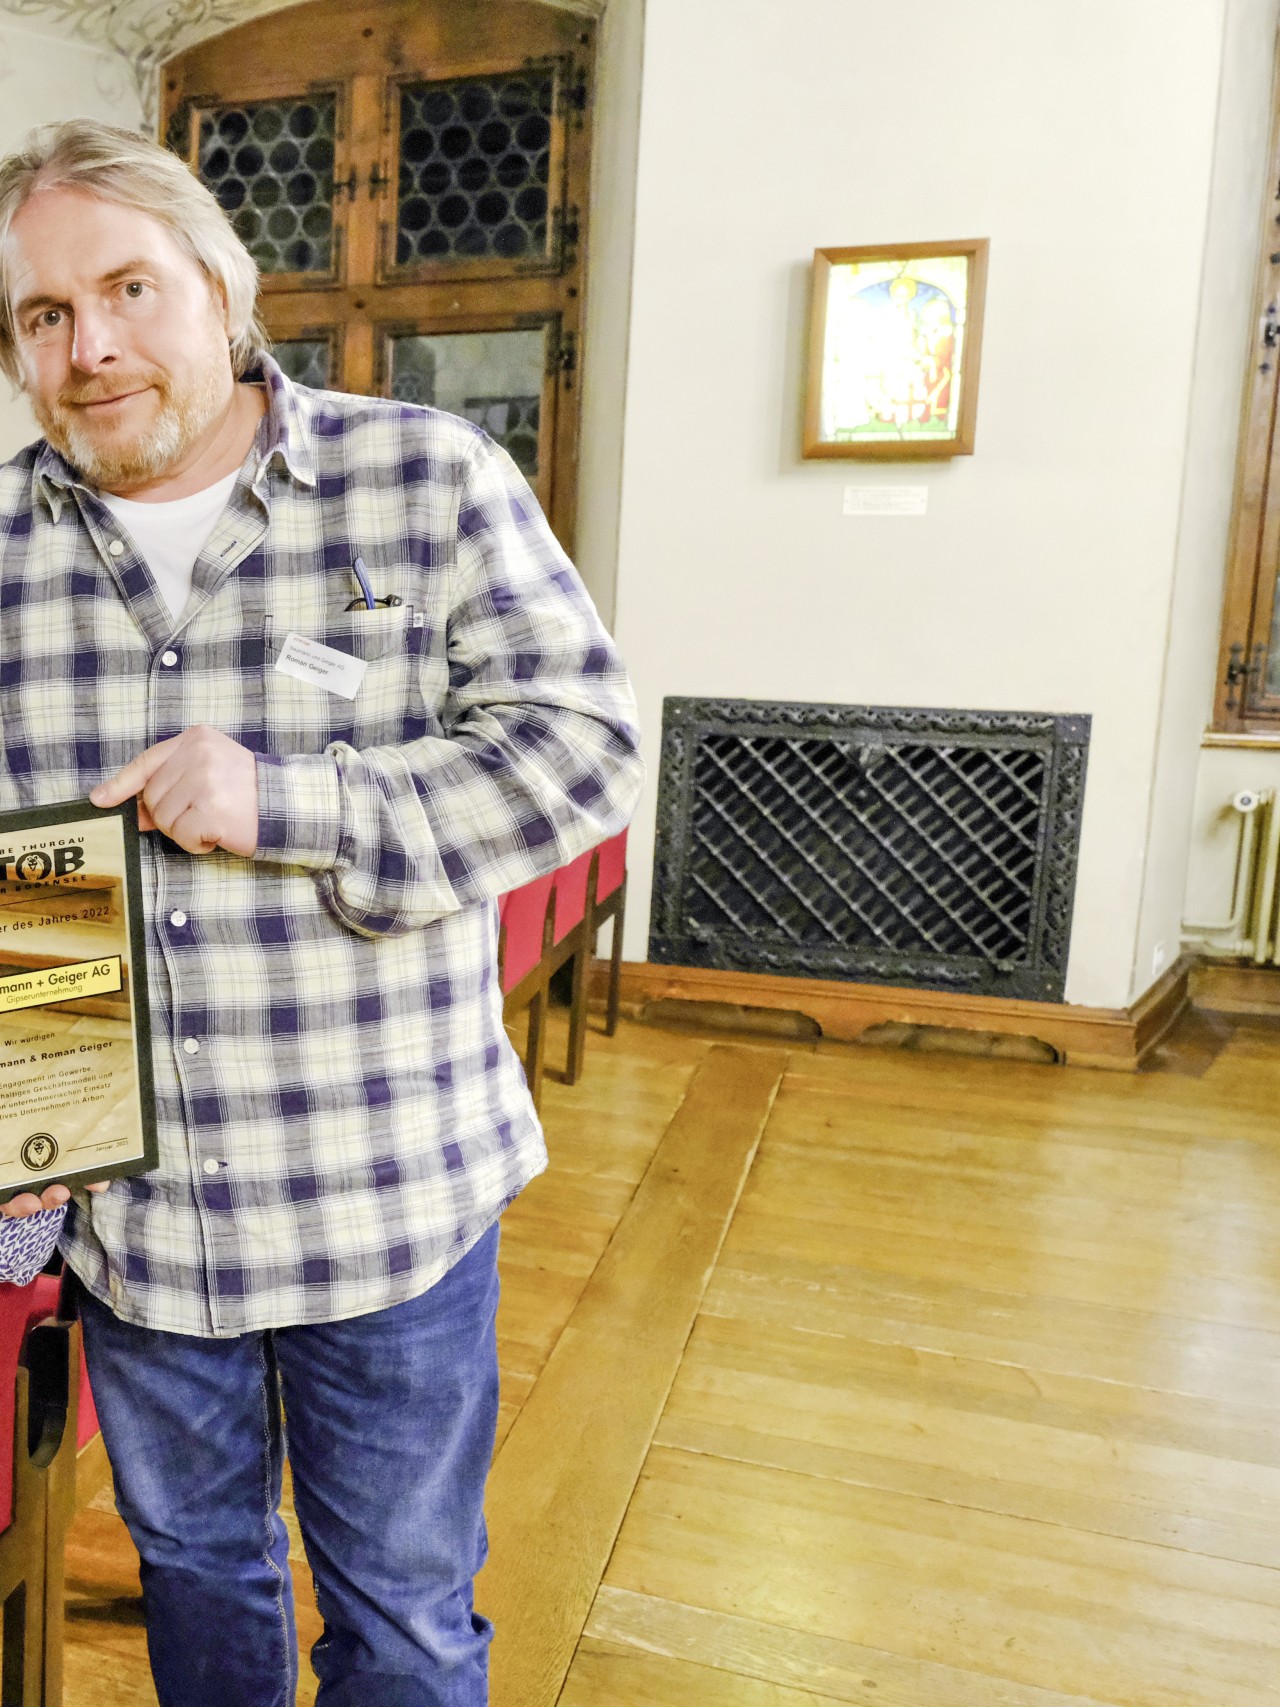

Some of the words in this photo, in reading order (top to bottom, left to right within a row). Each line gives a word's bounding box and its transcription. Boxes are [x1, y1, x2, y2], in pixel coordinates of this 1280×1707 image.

[285, 654, 308, 667] Roman
[308, 663, 329, 675] Geiger
[21, 837, 85, 851] THURGAU
[15, 874, 87, 892] BODENSEE
[12, 920, 33, 932] des
[38, 913, 78, 927] Jahres
[82, 906, 110, 919] 2022
[36, 980, 45, 988] +
[48, 972, 88, 985] Geiger
[92, 963, 111, 978] AG
[6, 983, 83, 1005] Gipserunternehmung
[4, 1038, 17, 1047] Wir
[29, 1055, 38, 1063] &
[41, 1048, 76, 1060] Roman
[79, 1041, 113, 1053] Geiger
[33, 1075, 97, 1093] Geschäftsmodell
[98, 1071, 113, 1080] und
[8, 1089, 82, 1108] unternehmerischen
[83, 1082, 111, 1093] Einsatz
[20, 1101, 71, 1116] Unternehmen
